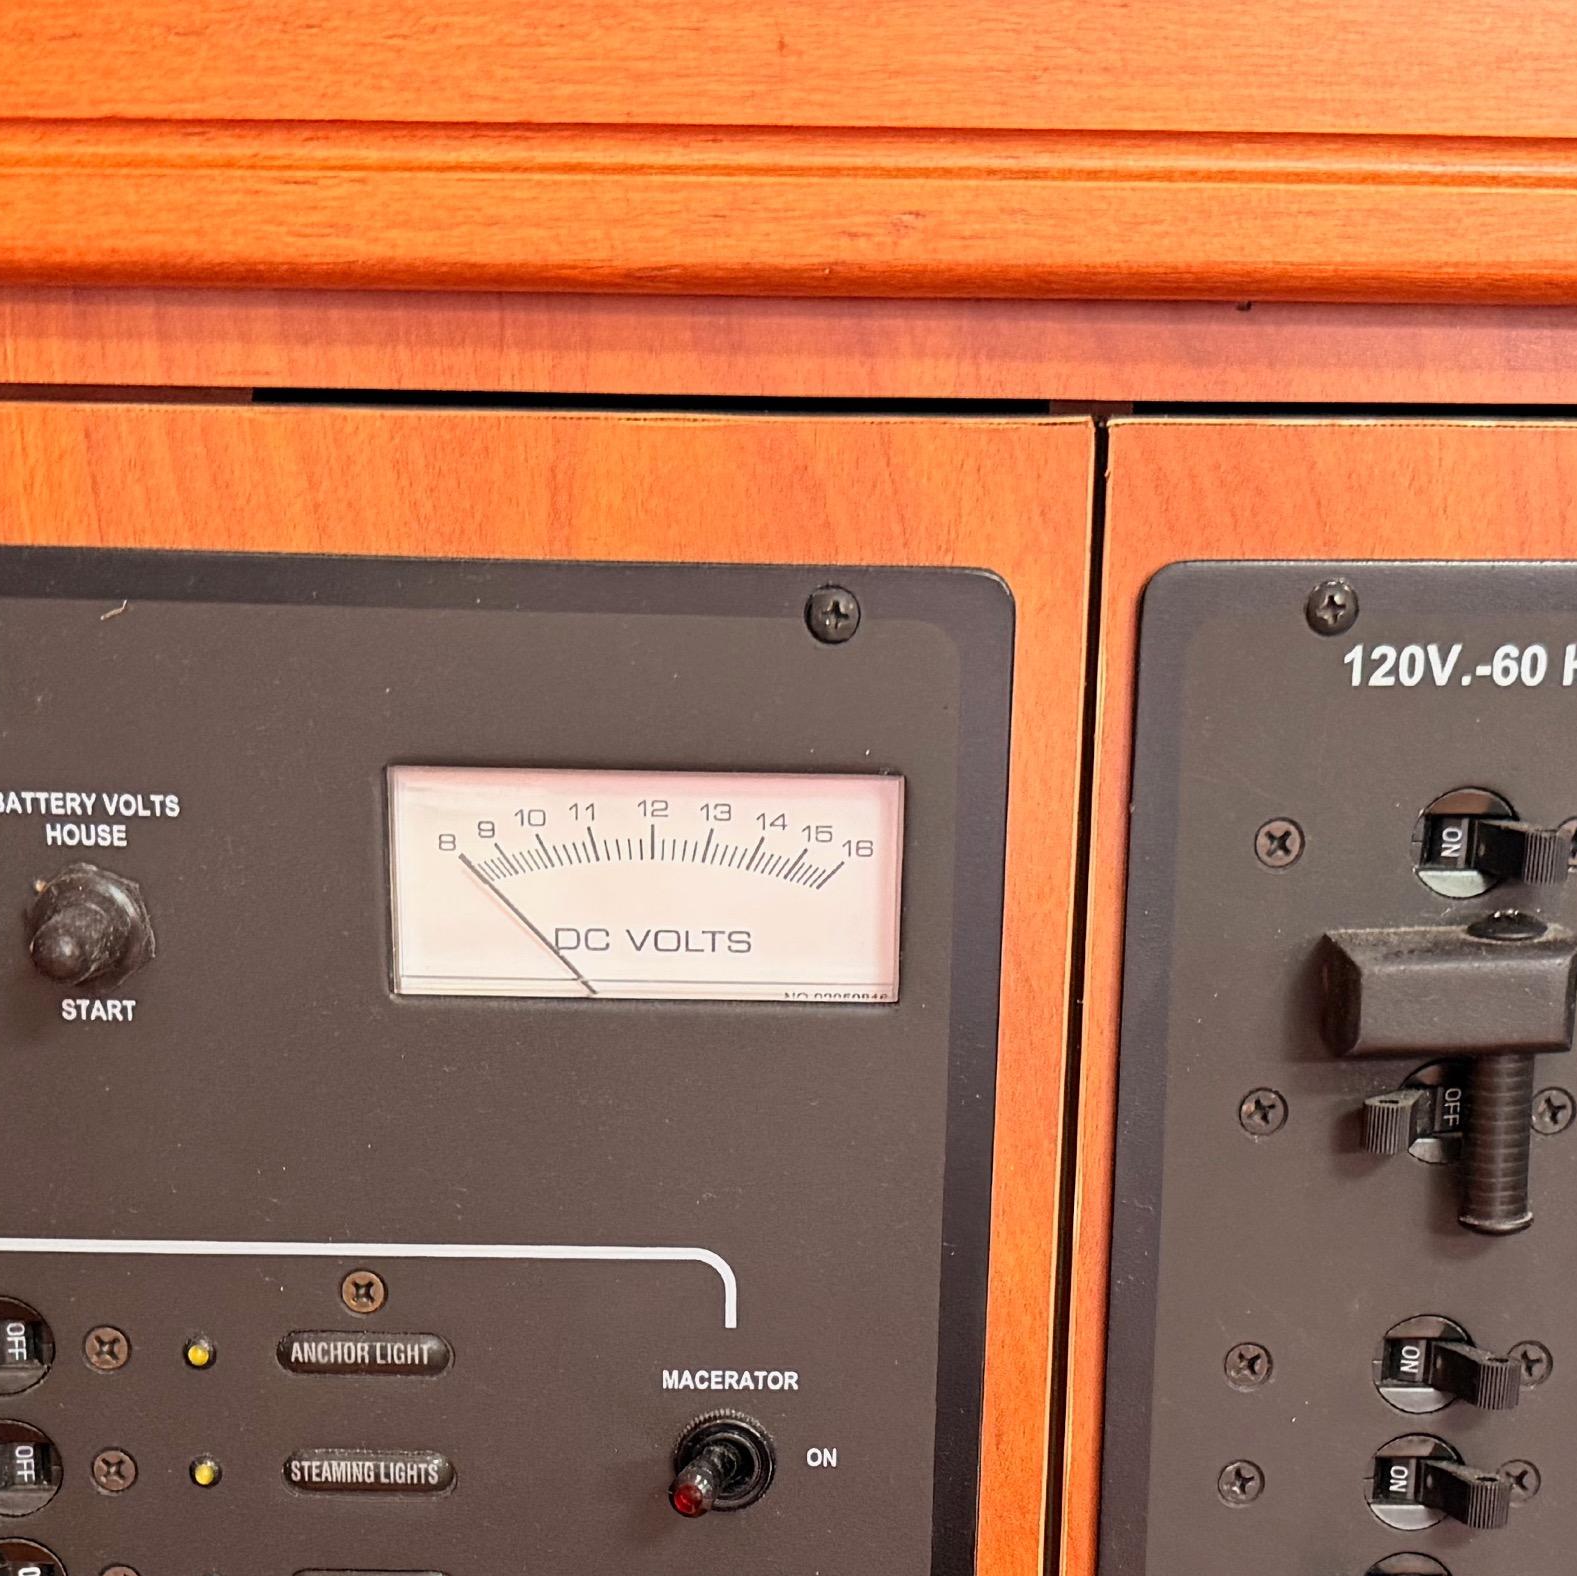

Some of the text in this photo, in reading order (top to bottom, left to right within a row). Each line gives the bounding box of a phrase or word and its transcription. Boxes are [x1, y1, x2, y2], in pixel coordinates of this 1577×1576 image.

[102, 793, 181, 818] VOLTS
[45, 823, 128, 847] HOUSE
[438, 799, 875, 858] 8 9 10 11 12 13 14 15 16
[1440, 826, 1462, 858] ON
[554, 928, 753, 954] DC VOLTS
[61, 999, 137, 1022] START
[1445, 1088, 1461, 1125] OFF
[6, 1321, 28, 1362] OFF
[290, 1342, 430, 1366] ANCHOR LIGHT
[1399, 1345, 1420, 1375] ON
[662, 1370, 799, 1390] MACERATOR
[15, 1445, 36, 1484] OFF
[807, 1447, 838, 1468] ON
[290, 1460, 439, 1485] STEAMING LIGHTS
[1389, 1464, 1409, 1493] ON
